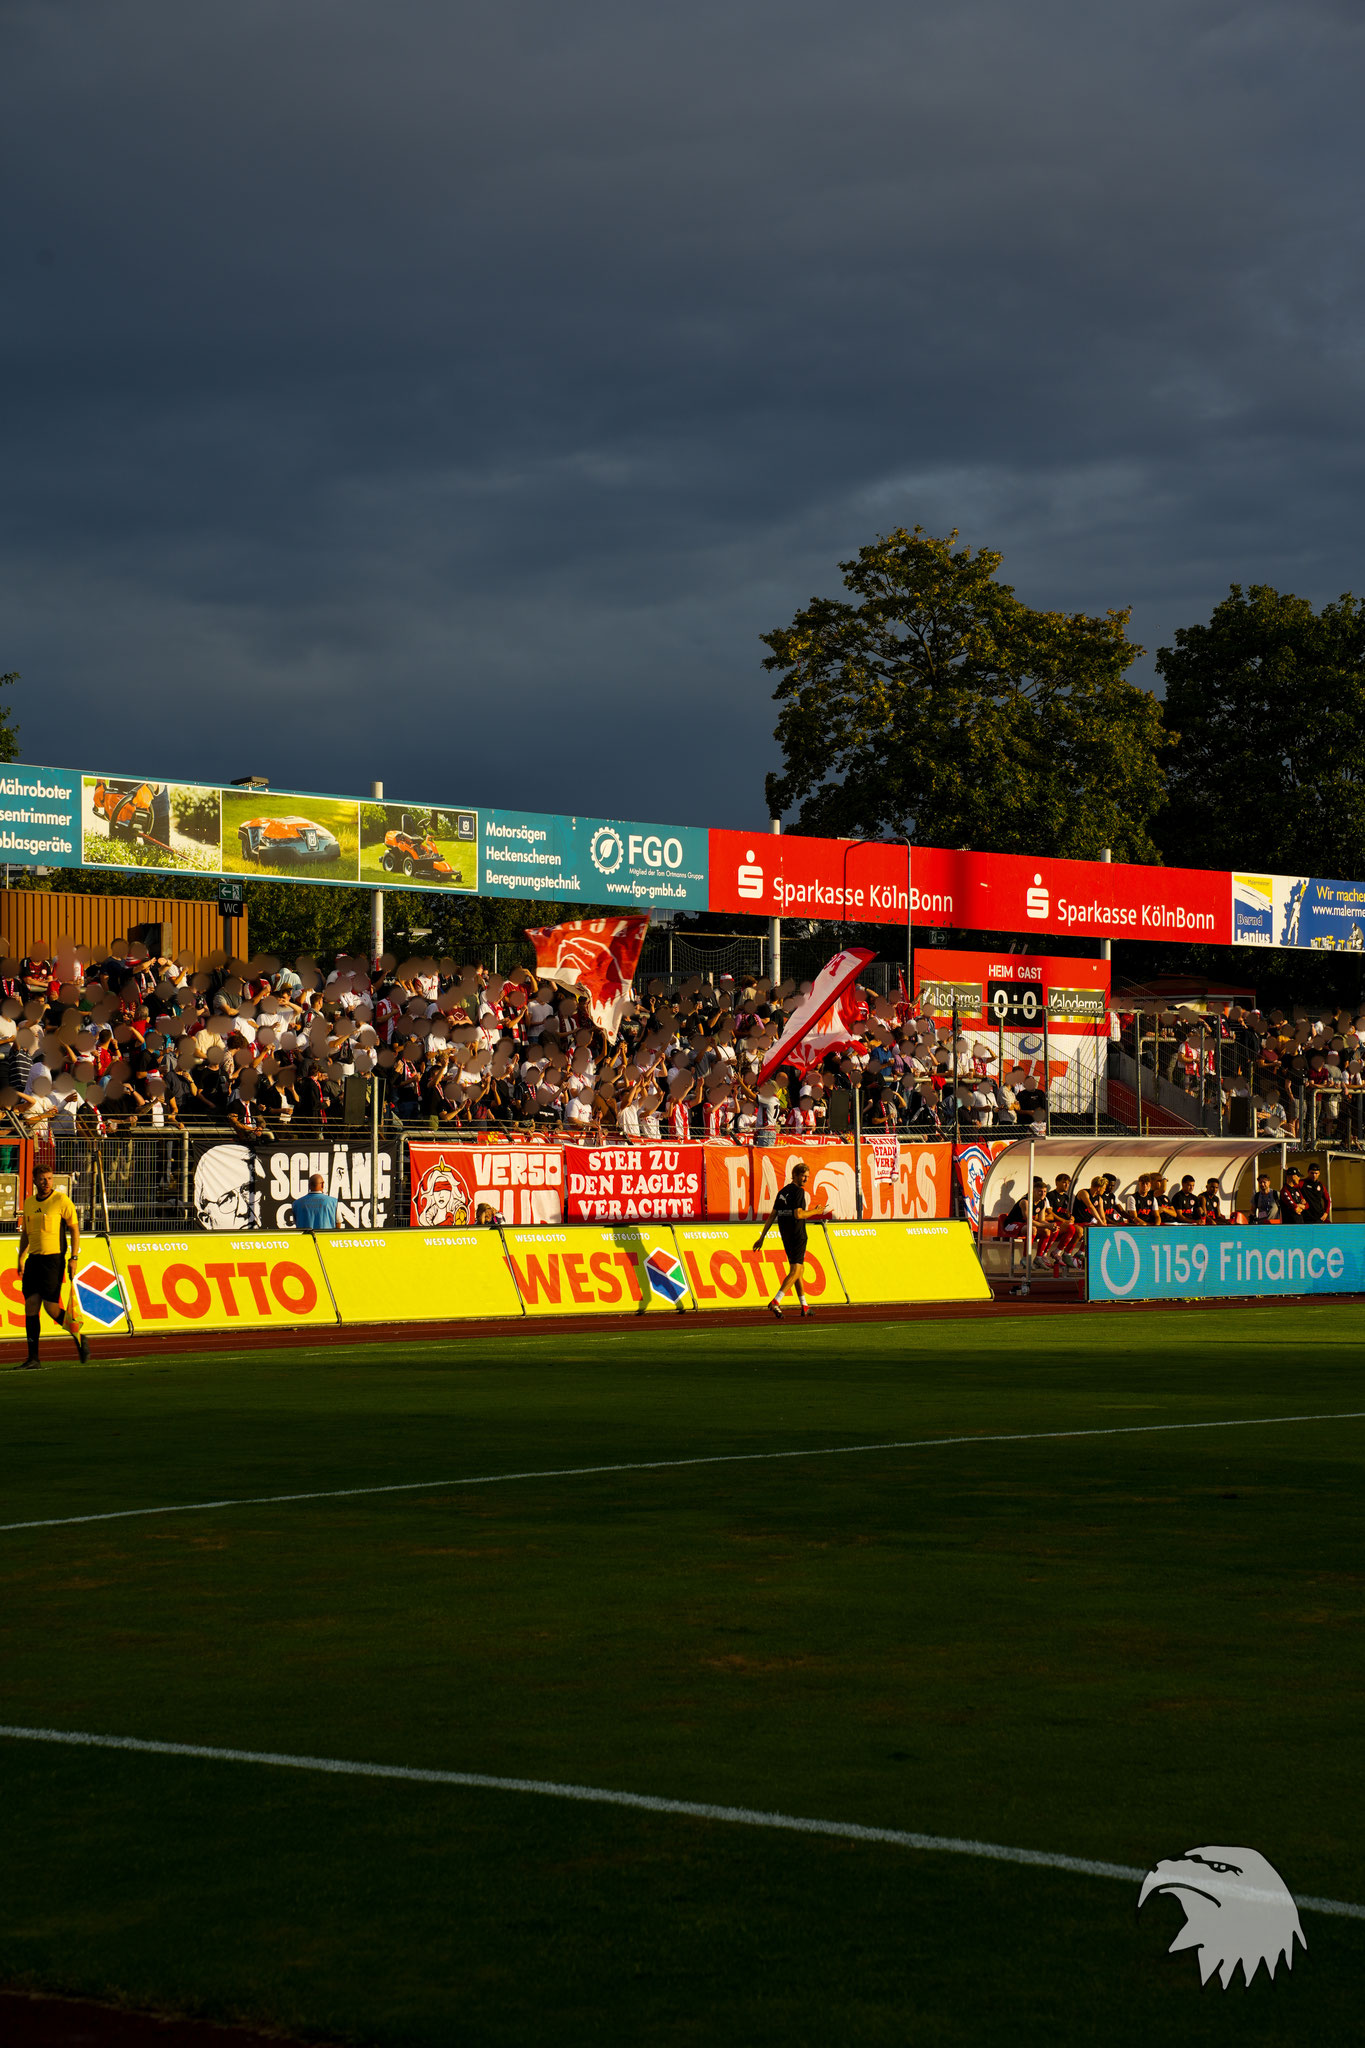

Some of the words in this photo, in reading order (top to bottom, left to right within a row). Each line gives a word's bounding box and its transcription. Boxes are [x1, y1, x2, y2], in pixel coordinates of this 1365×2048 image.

[485, 821, 547, 844] Motorsägen
[485, 845, 562, 866] Heckenscheren
[627, 834, 683, 869] FGO
[485, 869, 581, 892] Beregnungstechnik
[606, 880, 688, 899] www.fgo-gmbh.de
[773, 877, 865, 907] Sparkasse
[869, 884, 954, 913] KölnBonn
[1316, 885, 1335, 901] Wir
[1336, 887, 1365, 903] mache
[223, 902, 239, 914] WC
[1057, 898, 1137, 927] Sparkasse
[1141, 904, 1215, 930] KölnBonn
[1237, 913, 1263, 927] Bernd
[1237, 928, 1271, 944] Lanius
[988, 963, 1014, 979] HEIM
[1017, 966, 1043, 980] GAST
[270, 1144, 392, 1201] SCHÄNG
[472, 1152, 562, 1186] VERSO
[588, 1150, 642, 1172] STEH
[649, 1149, 680, 1171] ZU
[569, 1173, 615, 1196] DEN
[620, 1171, 699, 1195] EAGLES
[276, 1201, 388, 1229] GNG
[577, 1197, 695, 1221] VERACHTE
[1151, 1242, 1209, 1284] 1159
[1219, 1240, 1345, 1282] Finance
[127, 1260, 318, 1320] LOTTO
[501, 1251, 644, 1305] WEST
